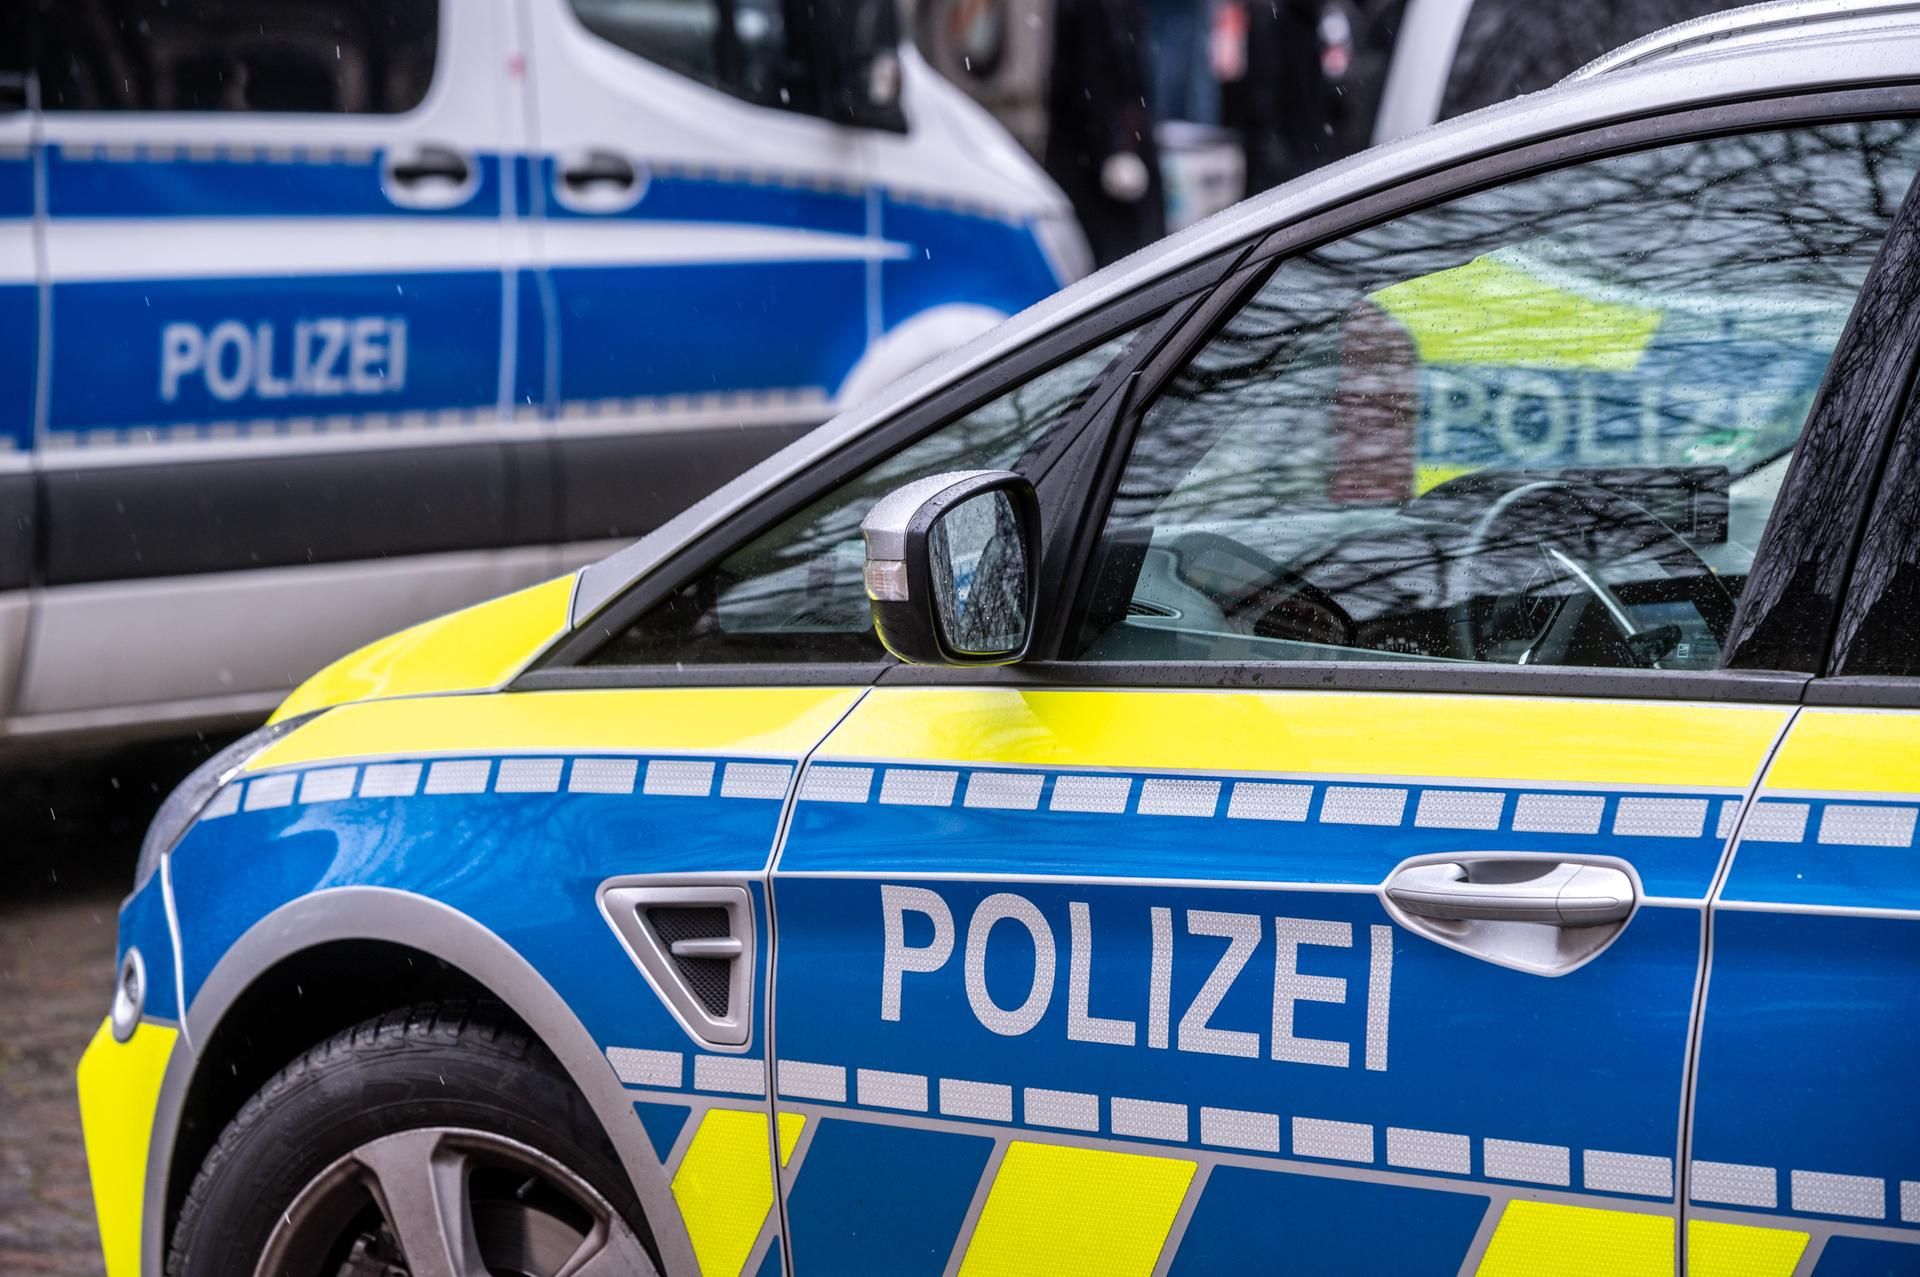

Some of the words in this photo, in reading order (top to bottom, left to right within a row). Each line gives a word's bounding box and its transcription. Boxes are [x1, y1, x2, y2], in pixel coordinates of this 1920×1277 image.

[161, 318, 406, 401] POLIZEI
[1429, 368, 1785, 463] POLI
[881, 884, 1393, 1072] POLIZEI
